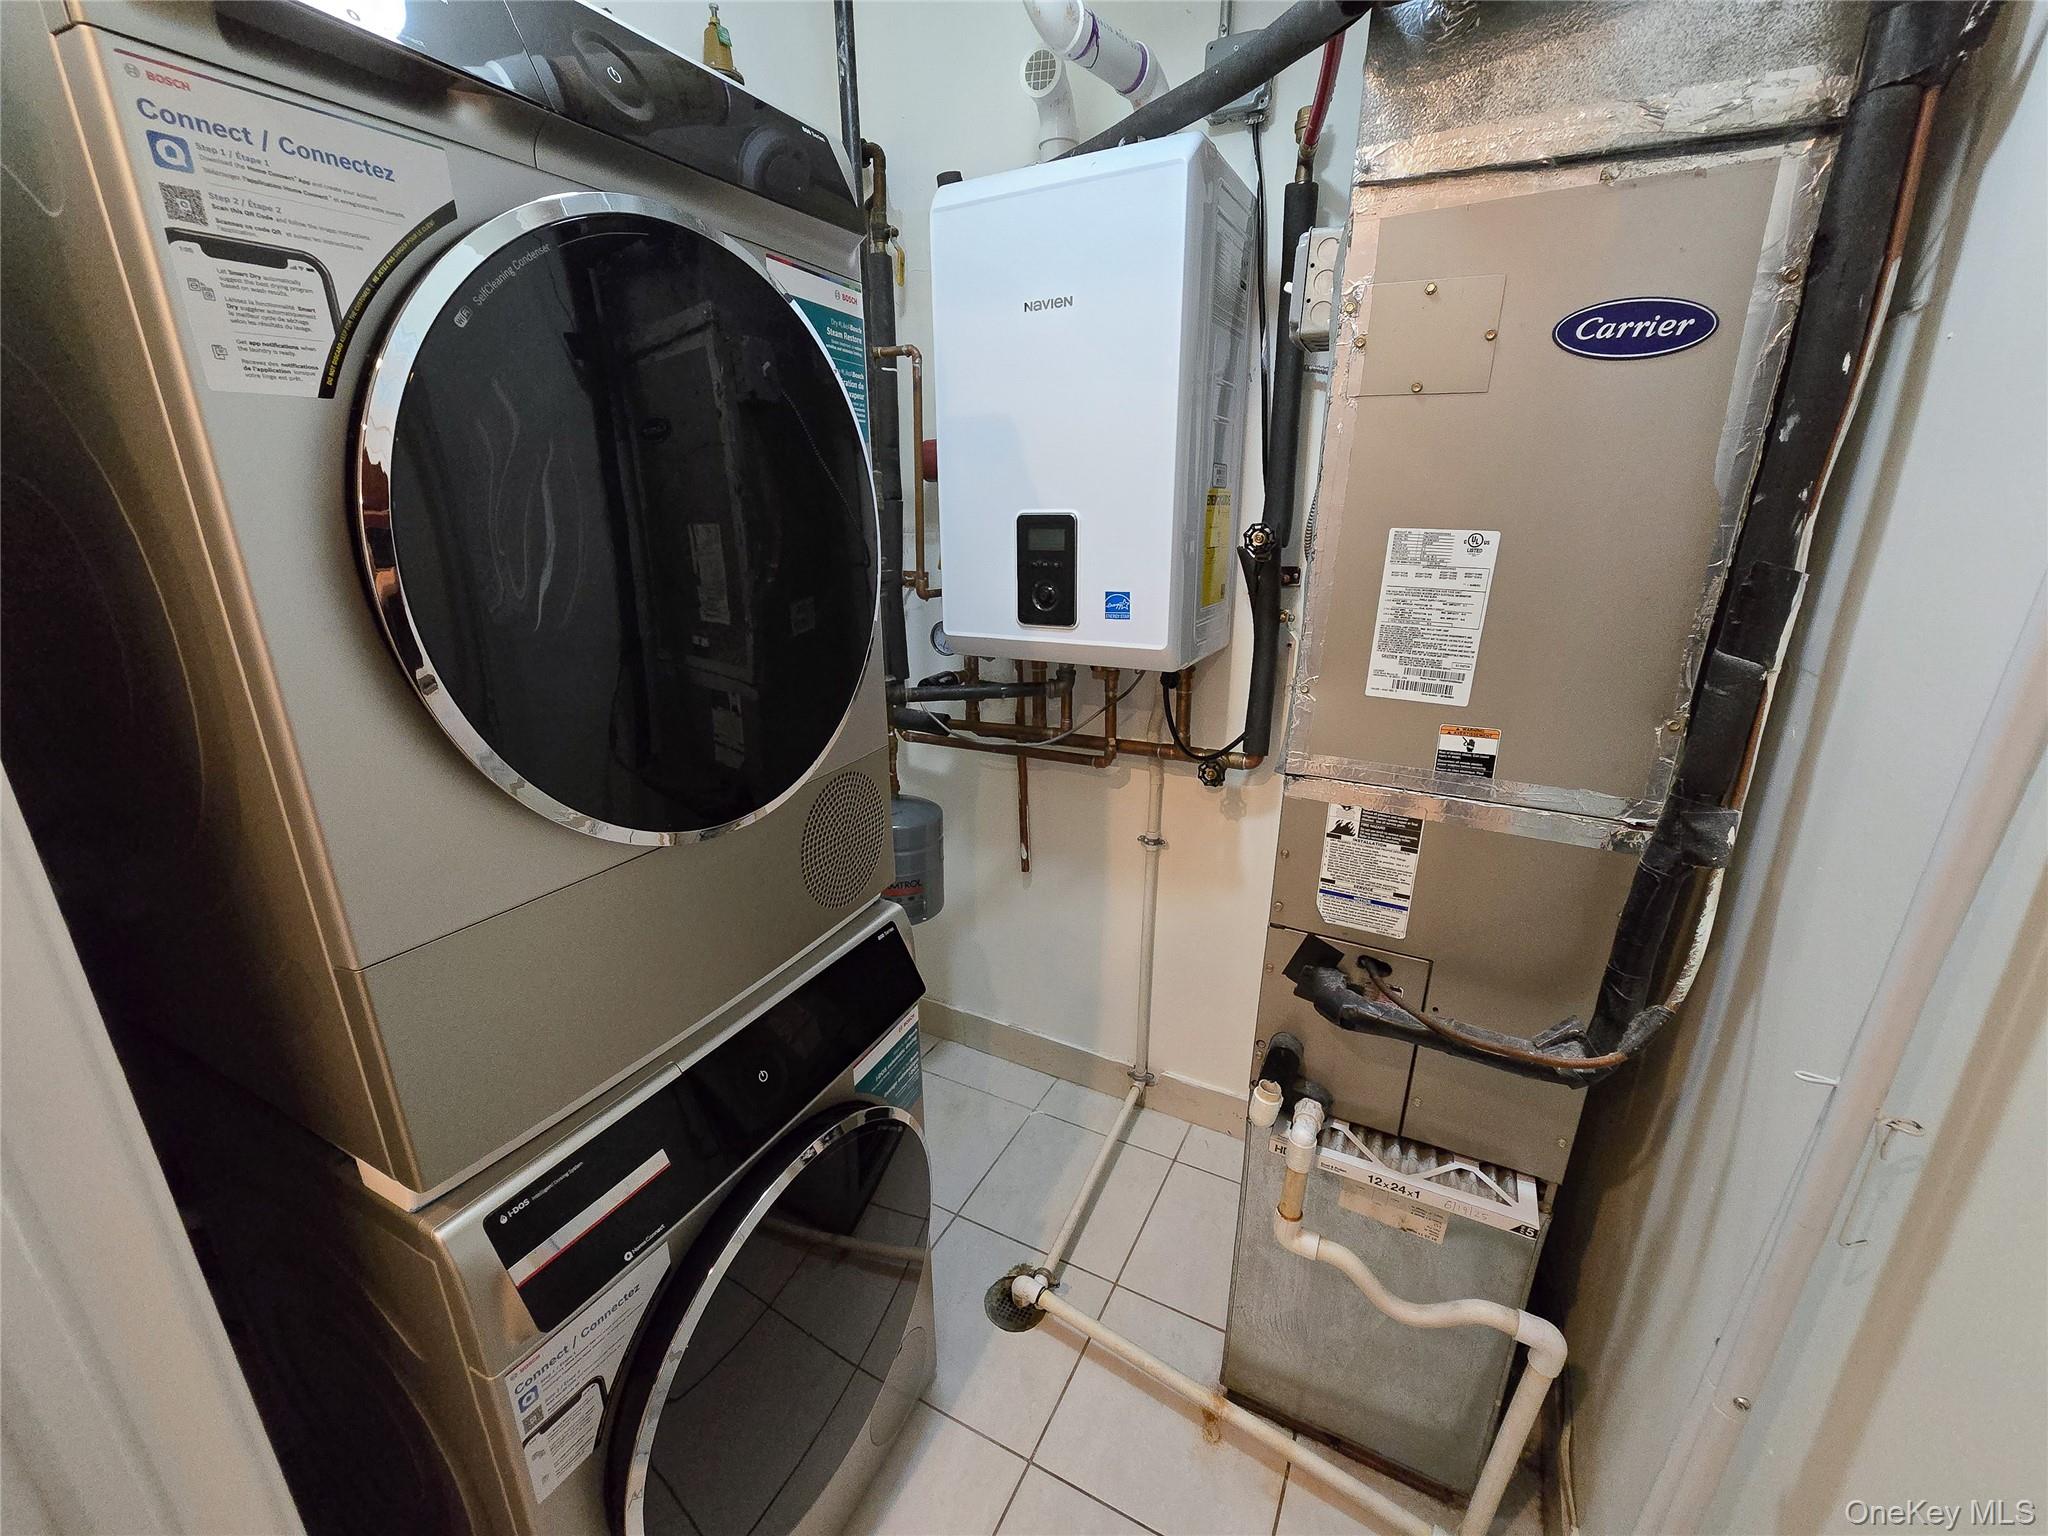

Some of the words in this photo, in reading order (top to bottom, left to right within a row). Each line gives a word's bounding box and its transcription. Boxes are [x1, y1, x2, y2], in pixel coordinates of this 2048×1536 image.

[145, 70, 191, 91] BOSCH
[137, 97, 254, 145] Connect
[262, 130, 269, 152] /
[279, 136, 396, 182] Connectez
[195, 142, 218, 155] Step
[208, 192, 230, 204] Step
[211, 203, 228, 212] Scan
[230, 207, 243, 215] this
[256, 212, 273, 221] Code
[271, 228, 282, 236] QR
[228, 269, 248, 278] Smart
[249, 272, 262, 281] Dry
[472, 265, 515, 306] SelfCleaning
[511, 242, 552, 271] Condenser
[841, 292, 858, 306] BOSCH
[226, 303, 239, 312] Dry
[1575, 314, 1696, 341] Carrier
[826, 326, 843, 339] Steam
[843, 331, 862, 345] Restore
[249, 341, 261, 349] app
[262, 341, 299, 351] notifications
[252, 366, 292, 376] l'application
[281, 361, 319, 371] notifications
[1352, 838, 1387, 848] INSTALLATION
[1525, 1227, 1535, 1237] 5
[514, 1345, 568, 1395] Connect
[580, 1283, 641, 1338] Connectez
